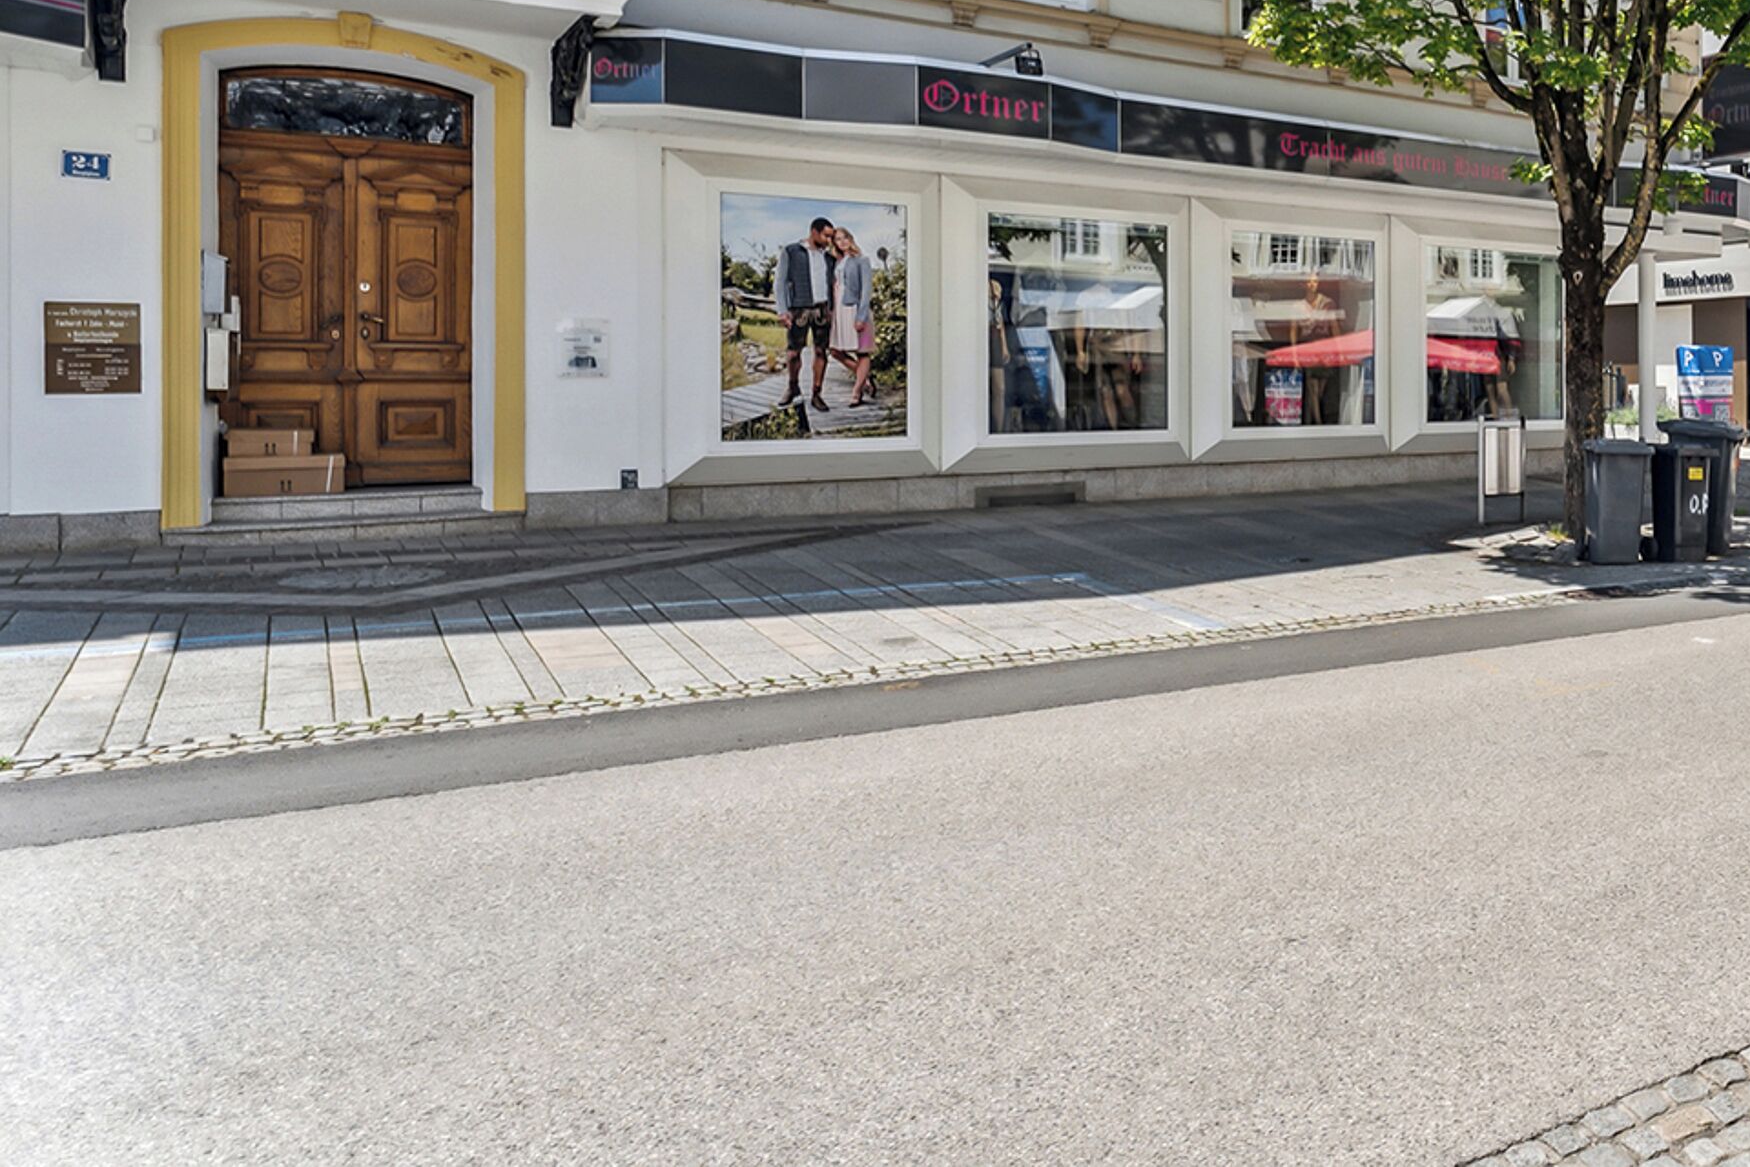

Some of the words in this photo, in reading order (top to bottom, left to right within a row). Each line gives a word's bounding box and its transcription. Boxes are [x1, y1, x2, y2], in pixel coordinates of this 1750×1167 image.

[594, 56, 659, 79] Ortner
[923, 79, 1046, 123] Ortner
[1280, 132, 1346, 162] Tracht
[1353, 145, 1387, 166] aus
[1393, 152, 1447, 179] gutem
[1663, 270, 1733, 290] limehome
[1712, 351, 1724, 367] P
